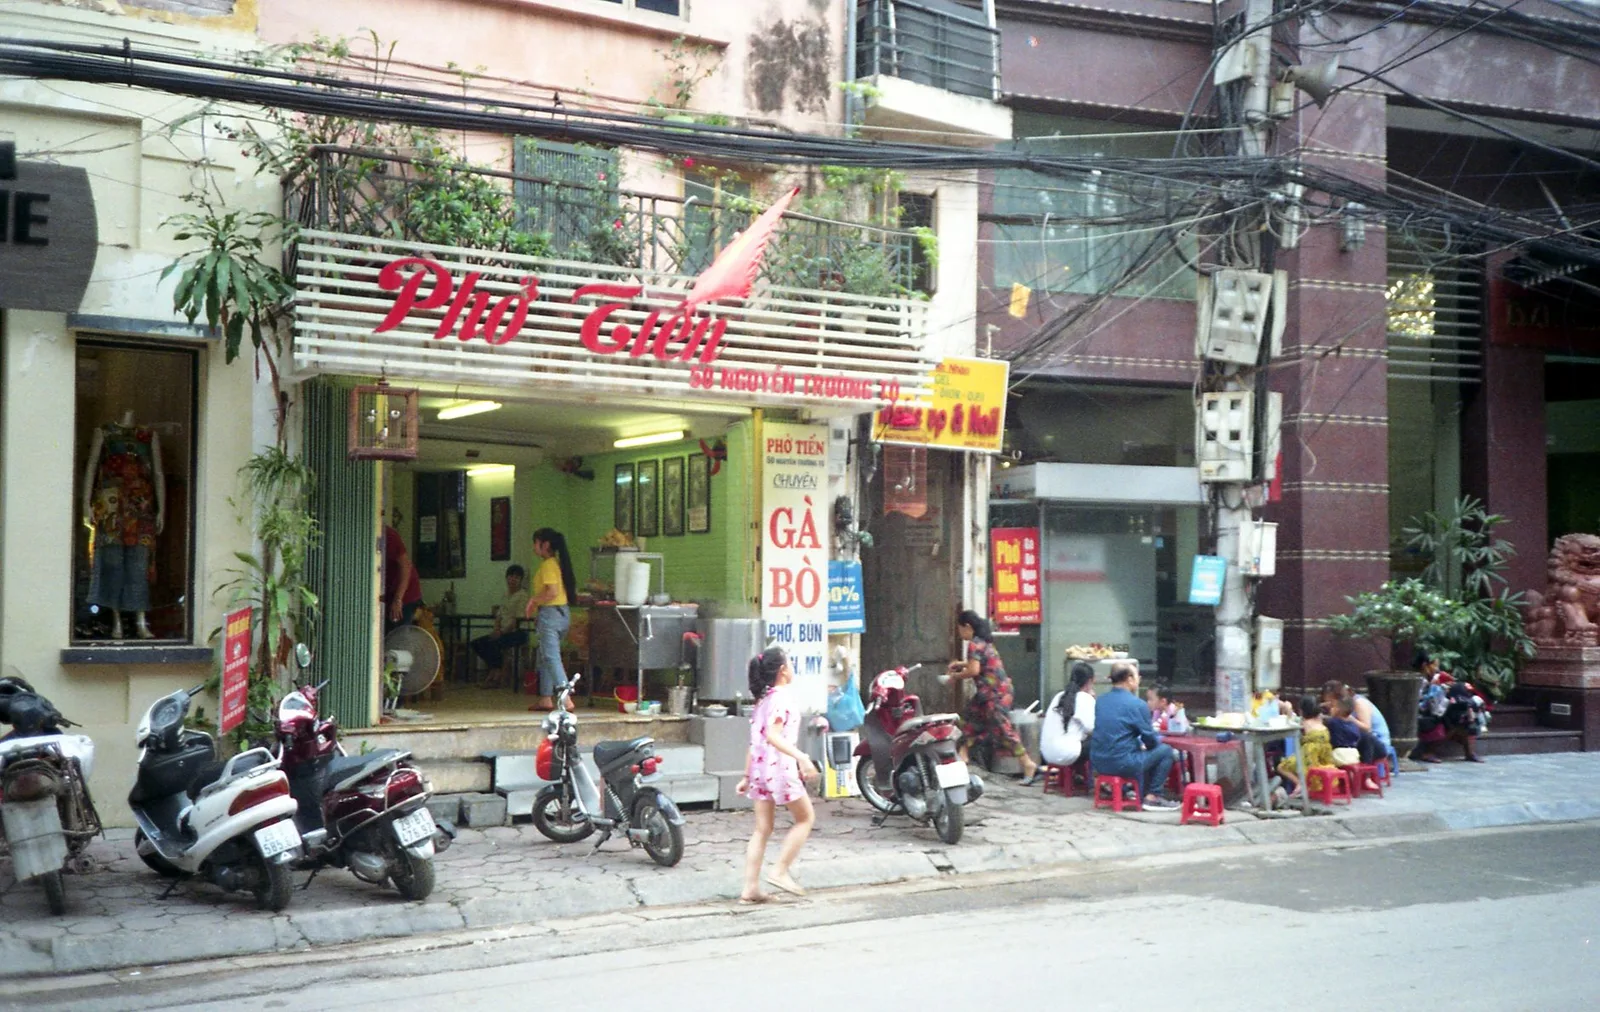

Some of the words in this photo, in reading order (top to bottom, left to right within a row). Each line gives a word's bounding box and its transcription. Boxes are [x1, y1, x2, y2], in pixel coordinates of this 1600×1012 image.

[373, 257, 540, 346] Phở
[689, 366, 715, 389] 50
[767, 433, 793, 454] PHỞ
[795, 433, 825, 456] TIẾN
[773, 471, 817, 490] CHUYÊN
[769, 495, 822, 549] GÀ
[996, 538, 1020, 565] Phở
[769, 555, 821, 608] BÒ
[828, 584, 860, 603] 0%
[799, 620, 823, 642] BÚN
